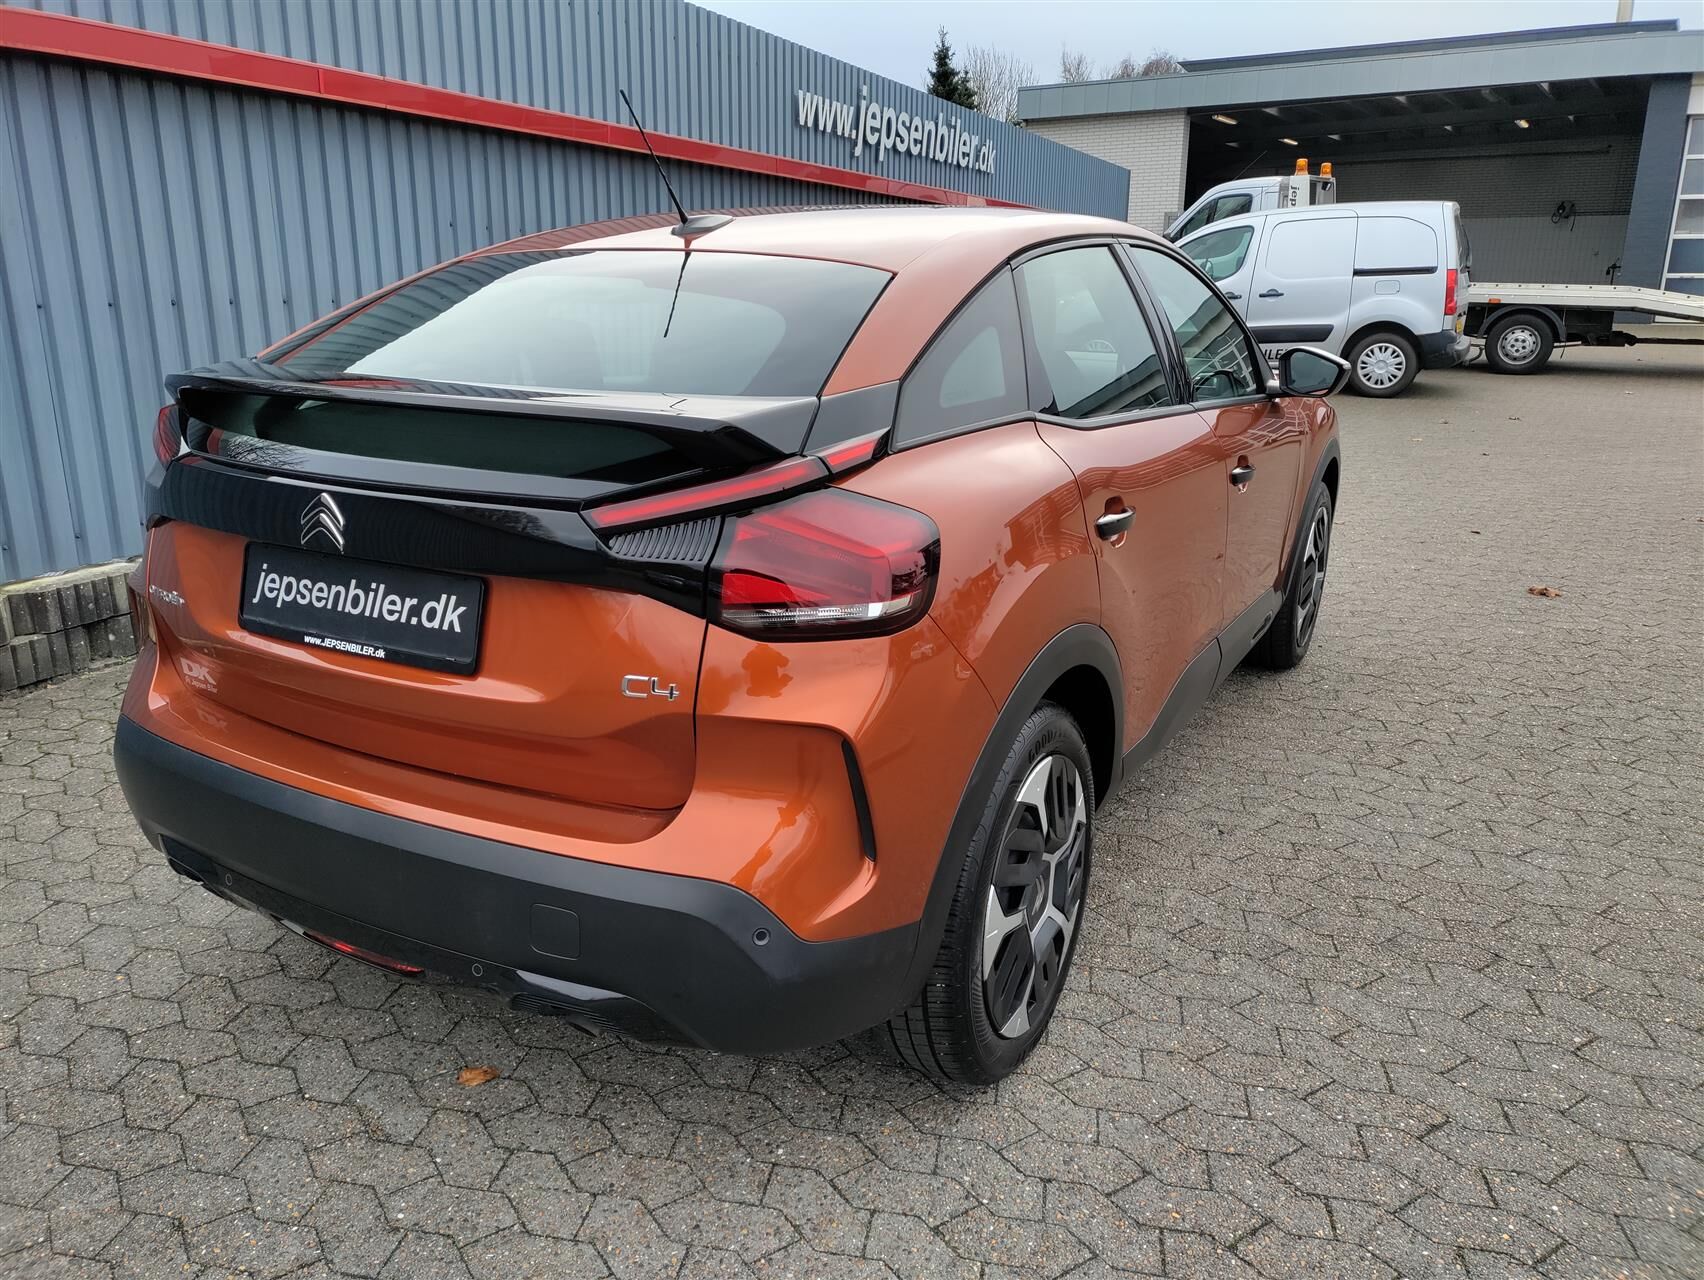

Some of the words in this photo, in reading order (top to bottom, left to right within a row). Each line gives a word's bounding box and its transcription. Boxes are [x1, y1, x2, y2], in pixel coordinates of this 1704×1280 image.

[798, 85, 995, 174] www.jepsenbiler.dk
[252, 563, 468, 633] jepsenbiler.dk
[304, 635, 386, 659] www.JEPSENBILER.dk
[622, 674, 680, 701] C4
